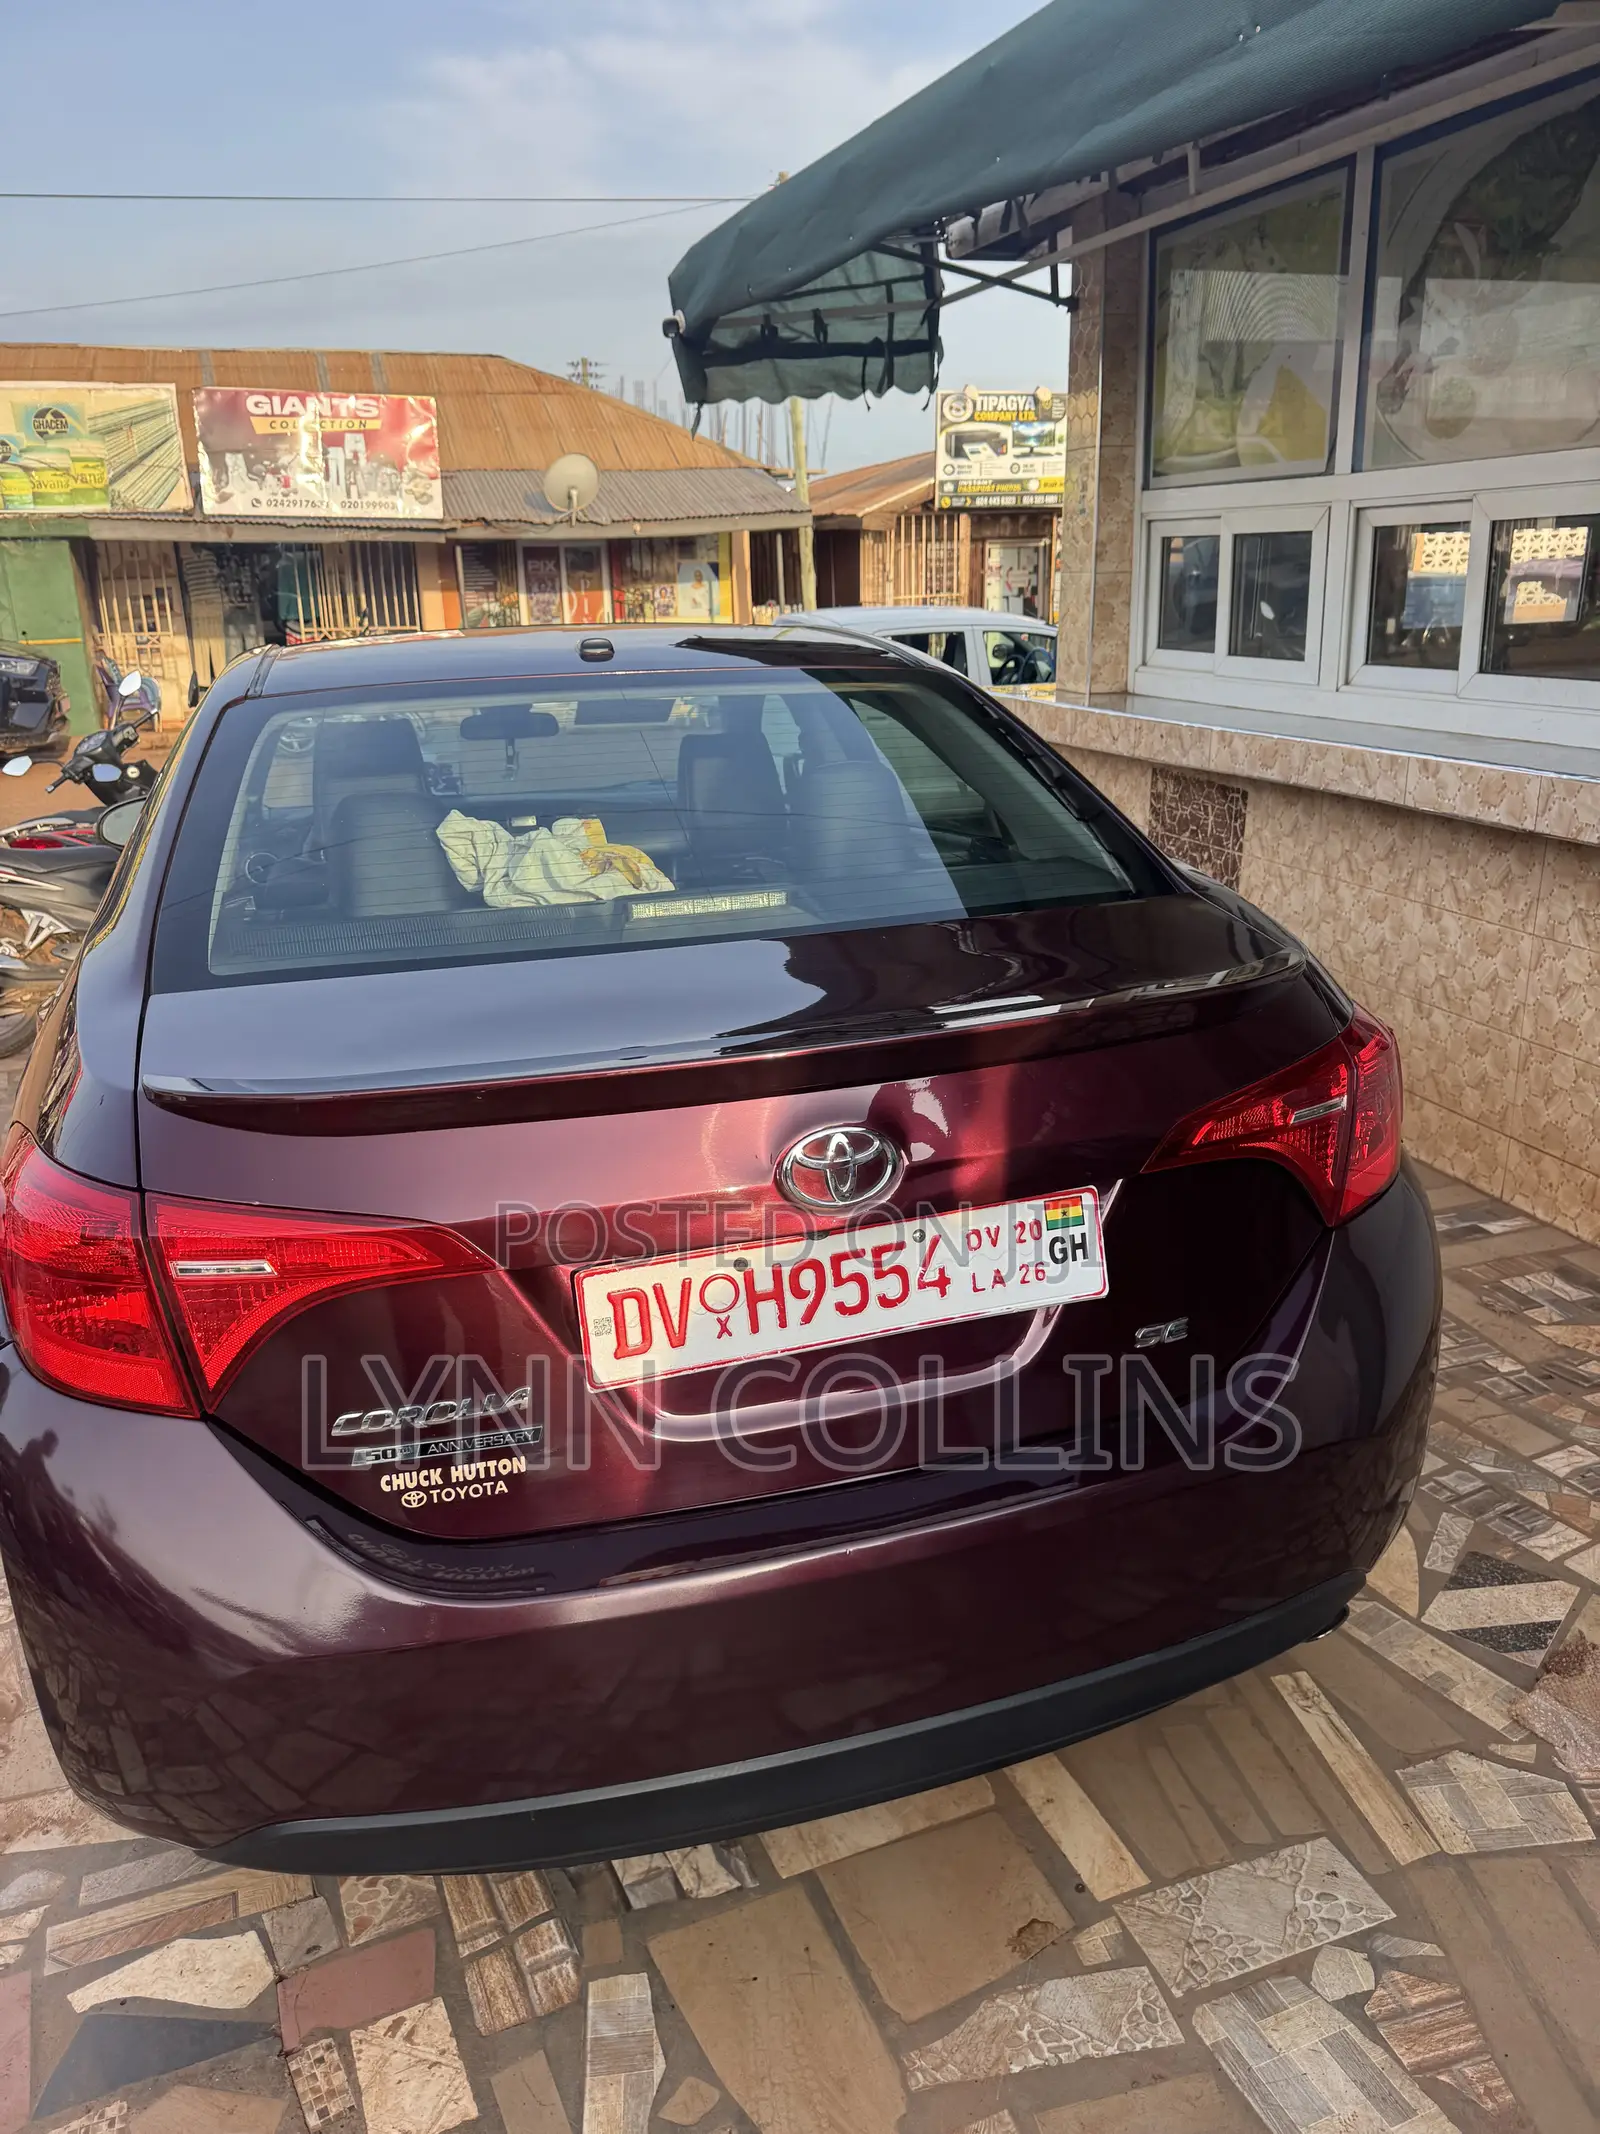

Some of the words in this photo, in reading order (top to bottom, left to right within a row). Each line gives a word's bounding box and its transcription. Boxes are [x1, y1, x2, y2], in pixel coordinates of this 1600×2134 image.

[246, 394, 379, 418] GIANTS
[976, 395, 1036, 411] TIPAGYA
[33, 418, 69, 430] GHACEM
[269, 420, 367, 429] COLCTION
[528, 560, 556, 571] PIX
[966, 1225, 1001, 1252] DV
[1013, 1218, 1043, 1244] 20
[1049, 1232, 1089, 1264] GH
[971, 1268, 1007, 1293] LA
[1019, 1261, 1046, 1285] 26
[607, 1277, 692, 1360] DV
[1134, 1317, 1189, 1348] SE
[331, 1386, 531, 1436] COROLLA
[427, 1429, 536, 1455] ANNIVERSARY
[380, 1467, 443, 1492] CHUCK
[450, 1456, 527, 1483] HUTTON
[429, 1480, 509, 1503] TOYOTA
